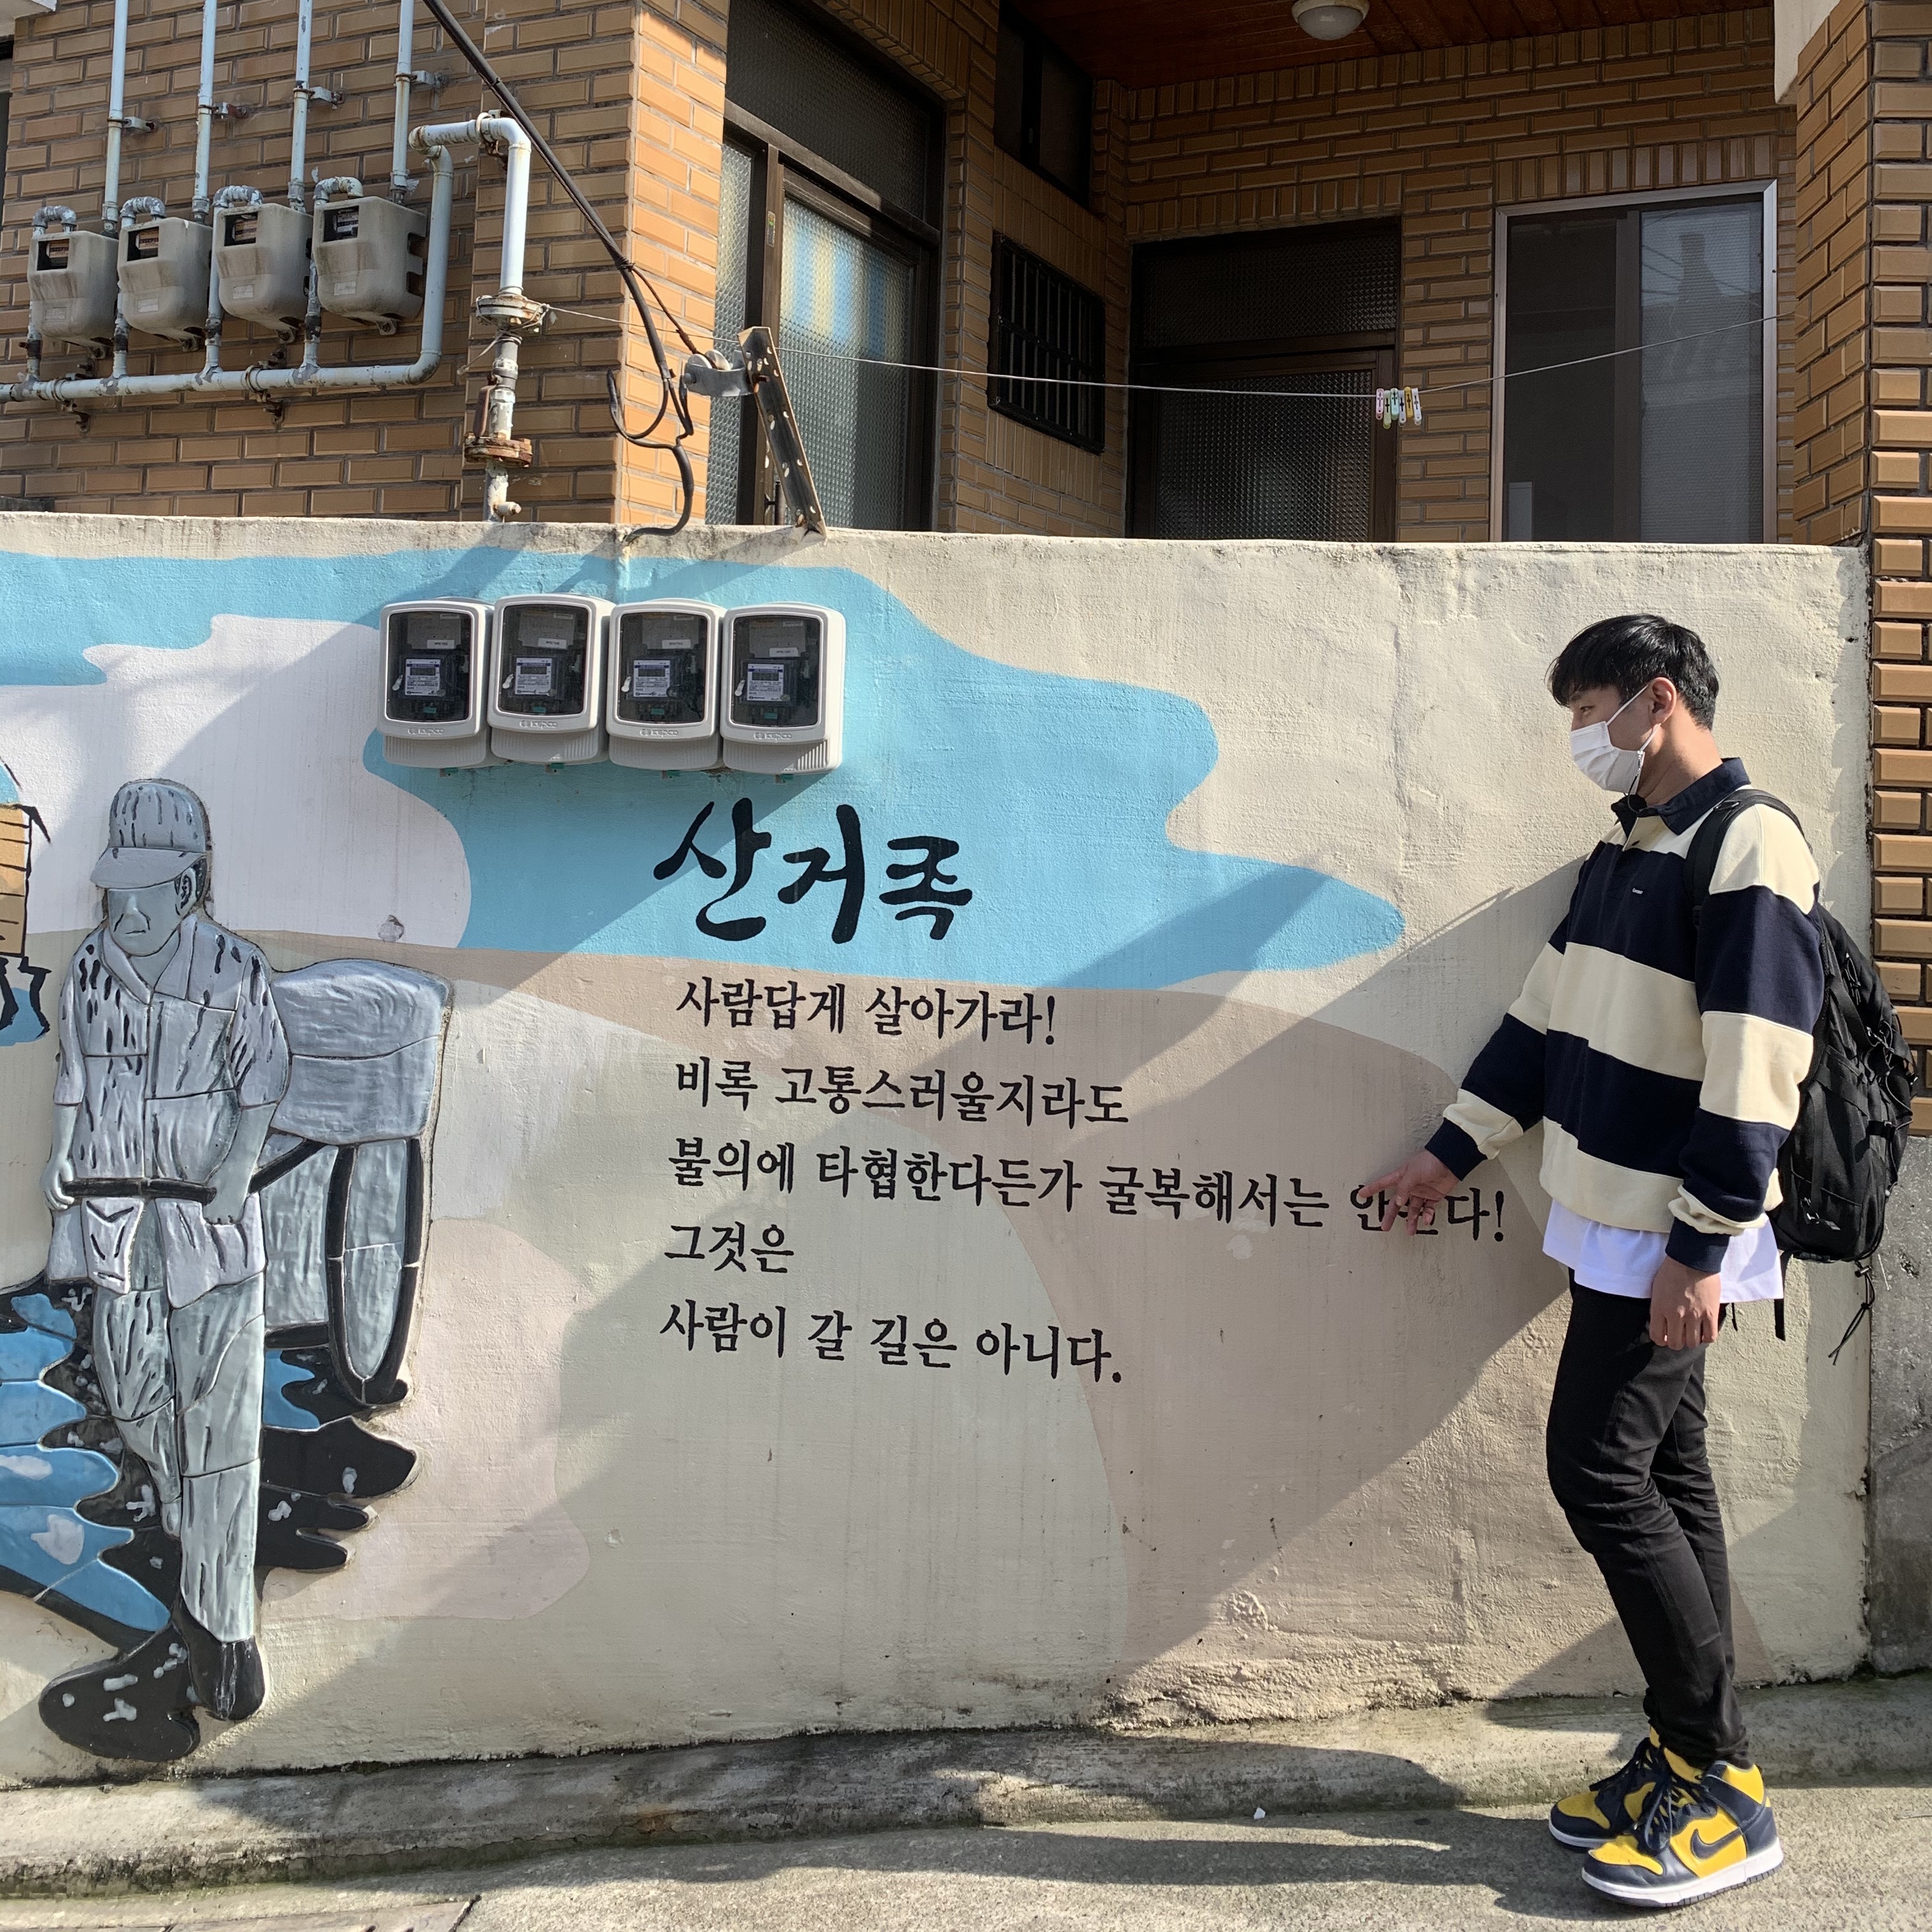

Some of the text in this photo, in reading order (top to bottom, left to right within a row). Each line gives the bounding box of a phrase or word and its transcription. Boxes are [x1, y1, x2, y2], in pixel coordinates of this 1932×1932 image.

[652, 796, 974, 945] 산거족
[675, 976, 1056, 1046] 사람답게 살아가라!
[675, 1055, 1130, 1130] 비록 고통스러울지라도
[667, 1136, 795, 1195] 불의에
[815, 1144, 1084, 1213] 타협한다든가
[1098, 1165, 1330, 1228] 굴복해서는
[663, 1220, 795, 1274] 그것은
[659, 1298, 1123, 1384] 사람이 갈 길은 아니다.
